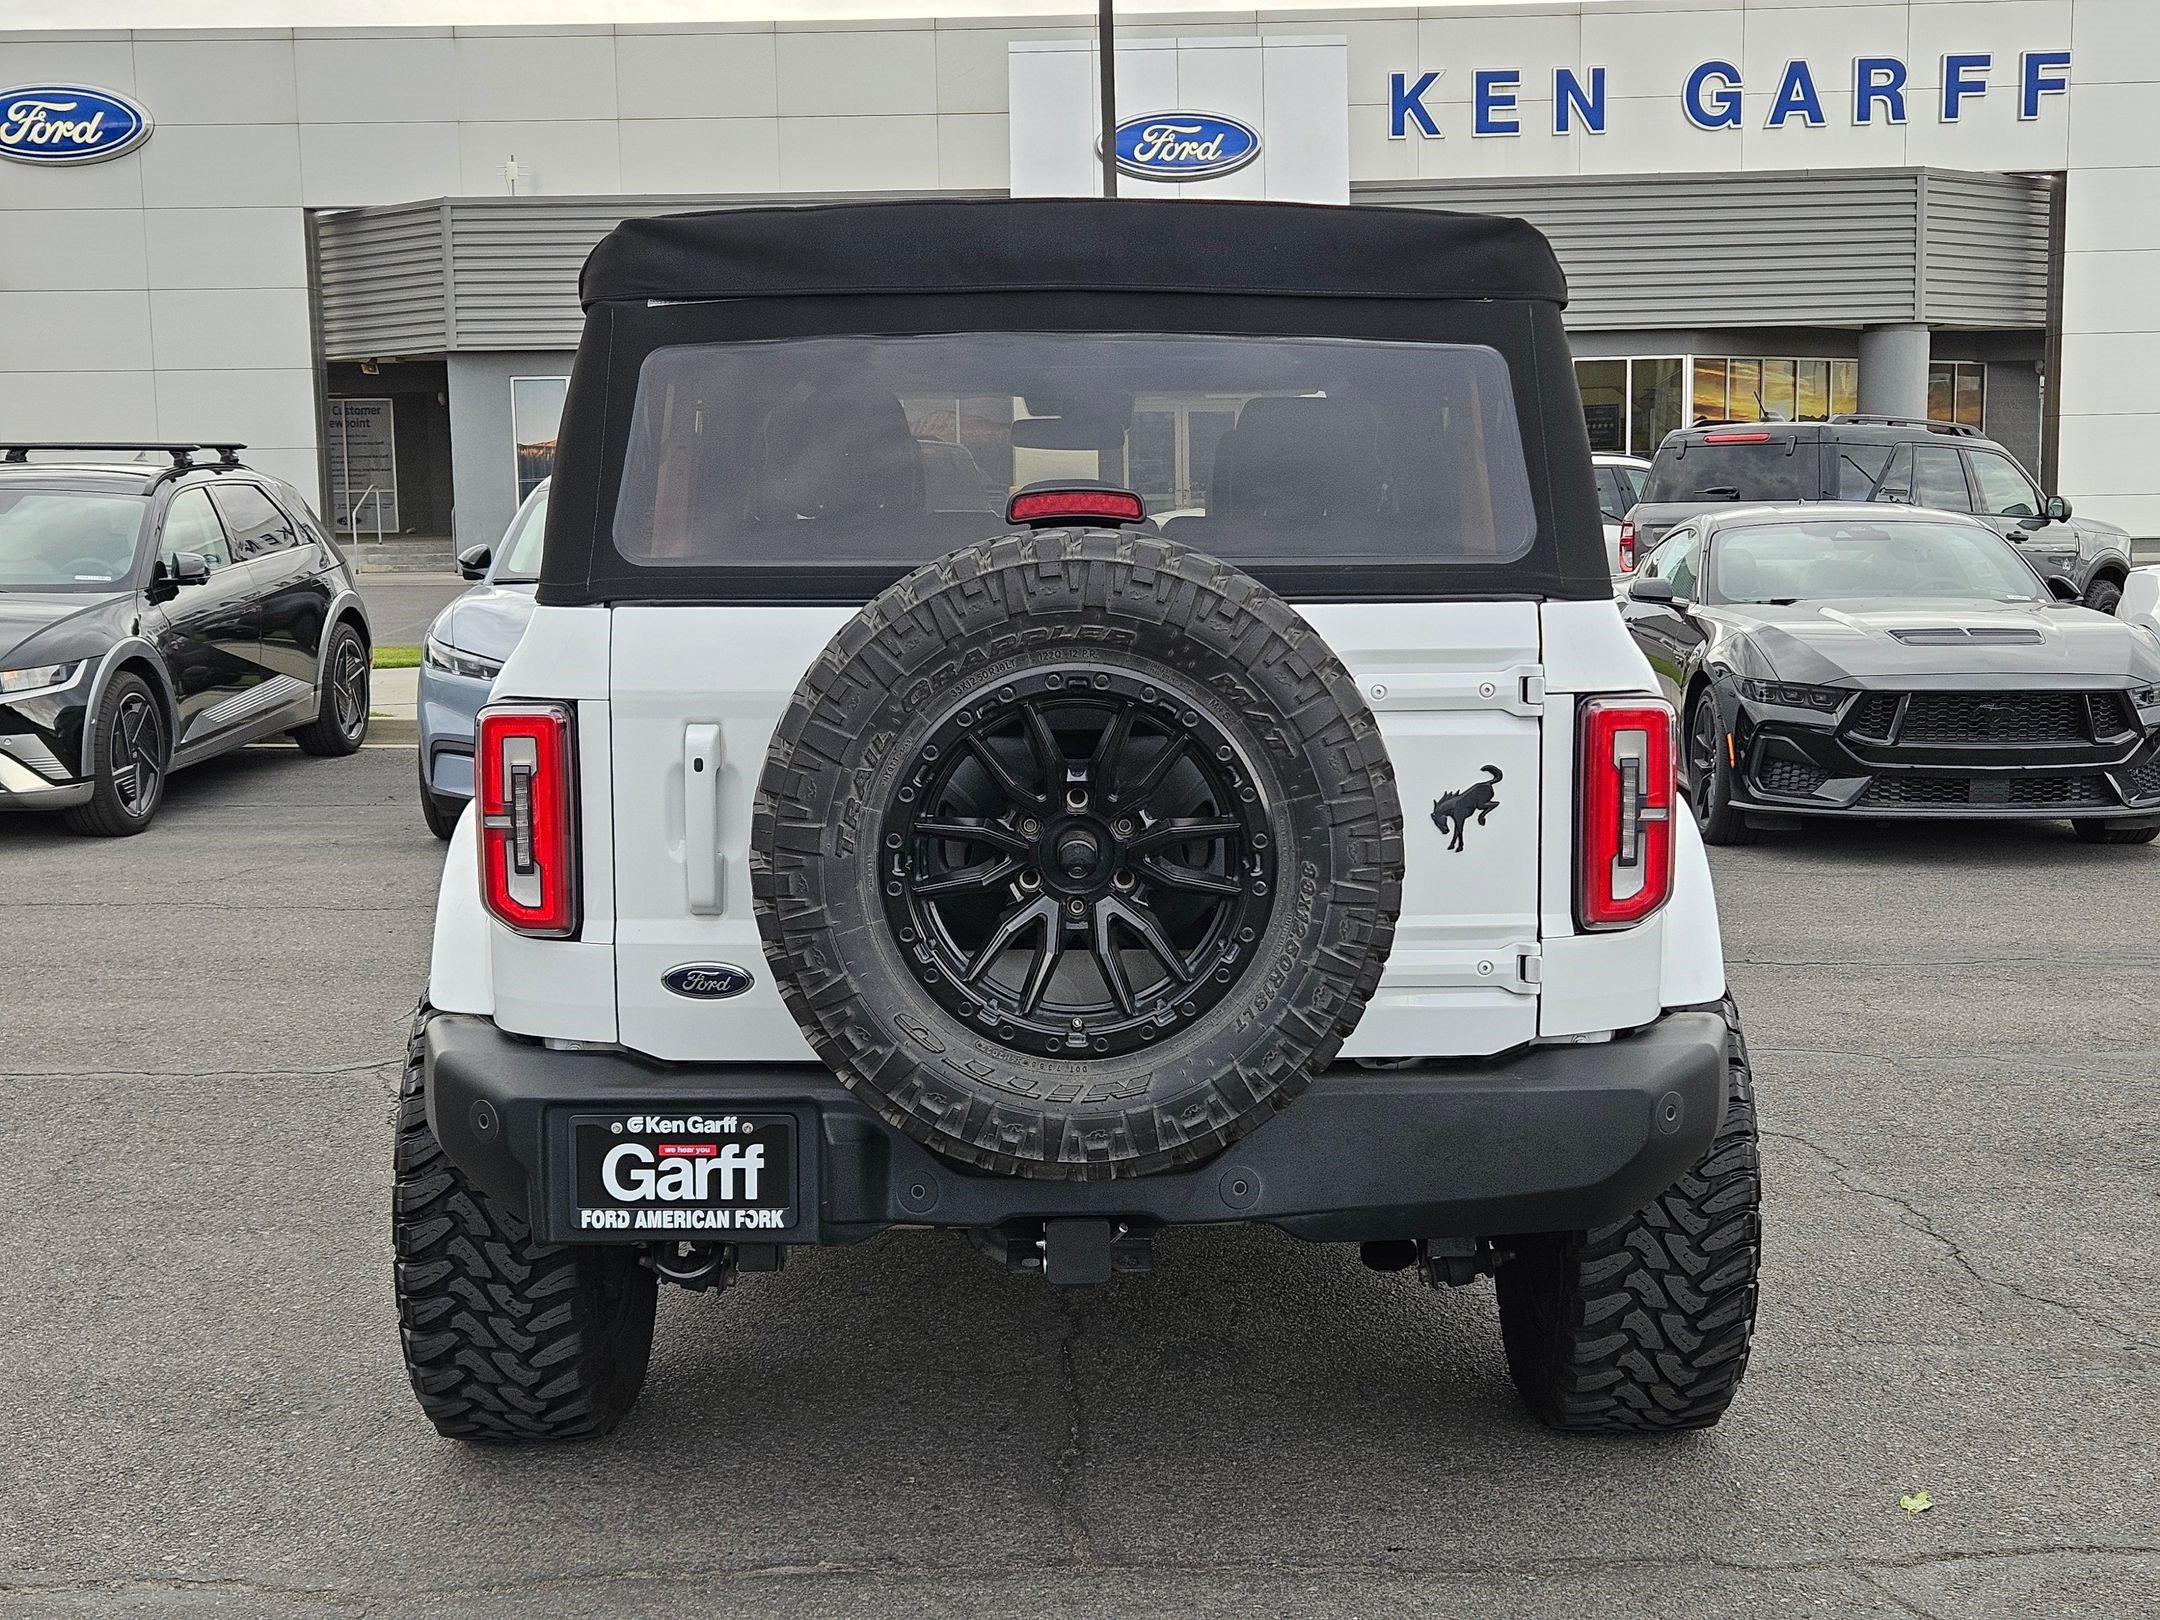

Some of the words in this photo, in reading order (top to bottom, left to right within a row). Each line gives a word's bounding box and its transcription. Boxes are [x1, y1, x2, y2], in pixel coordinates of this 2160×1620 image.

[1388, 64, 1607, 140] KEN
[1682, 49, 2074, 131] GARFF
[0, 100, 104, 145] Ford
[1133, 124, 1225, 162] Ford
[835, 733, 896, 858] TRAIL
[902, 624, 1138, 712] GRAPPLER
[682, 969, 732, 993] Ford
[646, 1116, 685, 1134] Ken
[687, 1116, 738, 1134] Garff
[602, 1143, 765, 1202] Garff
[581, 1210, 630, 1229] FORD
[634, 1210, 730, 1229] AMERICAN
[735, 1210, 784, 1229] FORK
